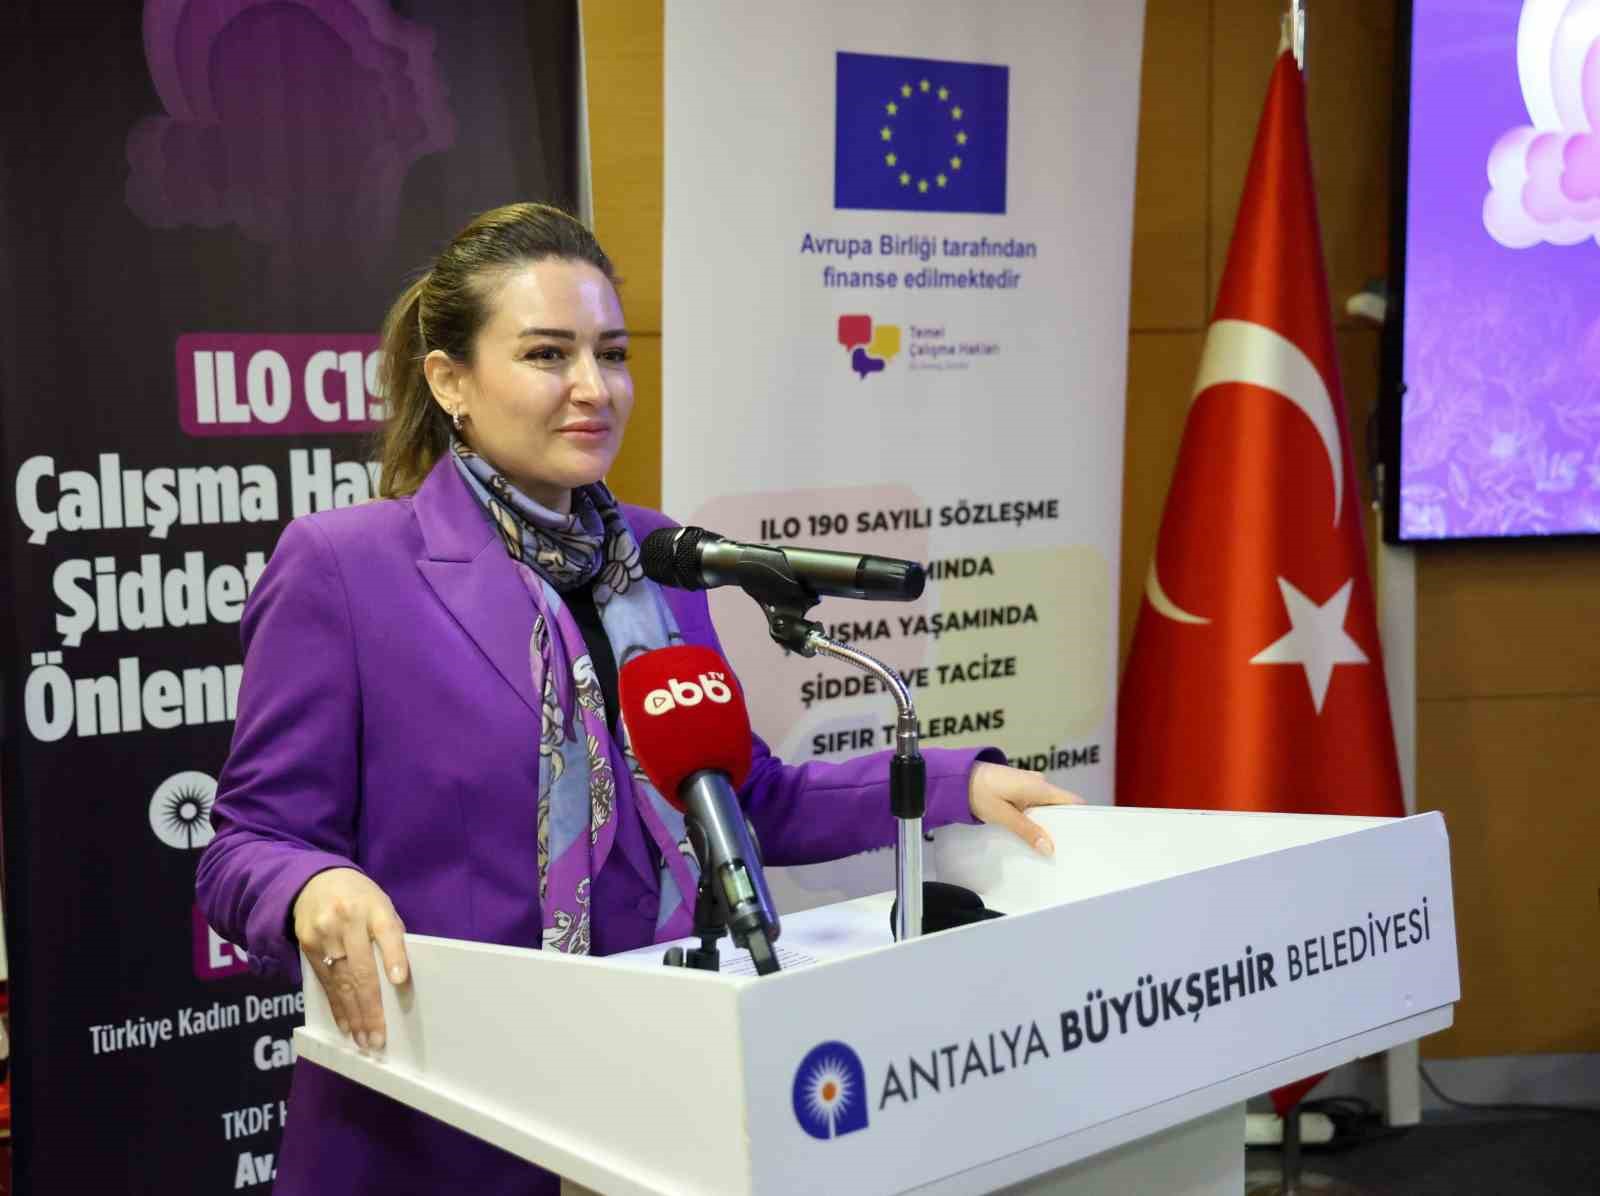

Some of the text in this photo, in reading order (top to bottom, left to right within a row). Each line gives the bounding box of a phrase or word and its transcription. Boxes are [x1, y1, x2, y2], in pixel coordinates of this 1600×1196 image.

[800, 233, 1037, 261] Avrupa Birliği tarafından
[823, 266, 1020, 288] finanse edilmektedir
[193, 349, 292, 424] ILO
[15, 452, 279, 545] Çalışma
[760, 500, 1060, 541] ILO 190 SAYILI SÖZLEŞME
[829, 603, 1039, 645] IŞMA YAŞAMINDA
[707, 671, 725, 681] TV
[936, 653, 1017, 686] TACİZE
[812, 709, 1006, 755] SIFIR TLERANS
[878, 896, 1432, 1111] ANTALYA BÜYÜKŞEHİR BELEDİYESİ
[89, 1018, 173, 1055] Türkiye
[178, 1001, 241, 1038] Kadın
[221, 1103, 275, 1141] TKDF
